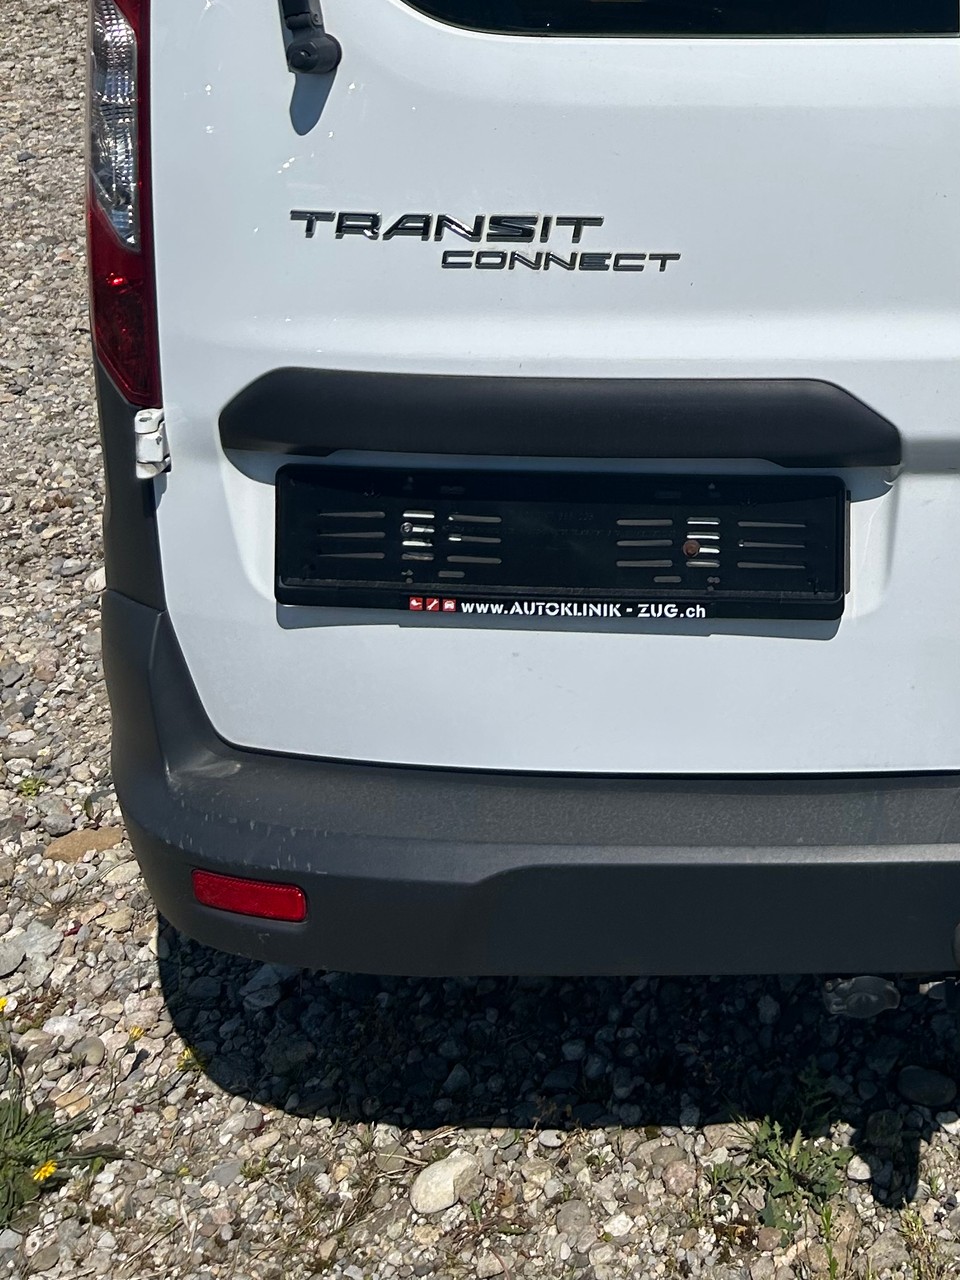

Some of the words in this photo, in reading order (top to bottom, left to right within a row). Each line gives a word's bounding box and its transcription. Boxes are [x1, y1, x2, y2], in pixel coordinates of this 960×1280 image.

[290, 209, 604, 243] TRANSIT
[441, 250, 680, 272] CONNECT
[461, 601, 622, 617] www.AUTOKLINIK
[637, 603, 706, 618] ZUG.ch
